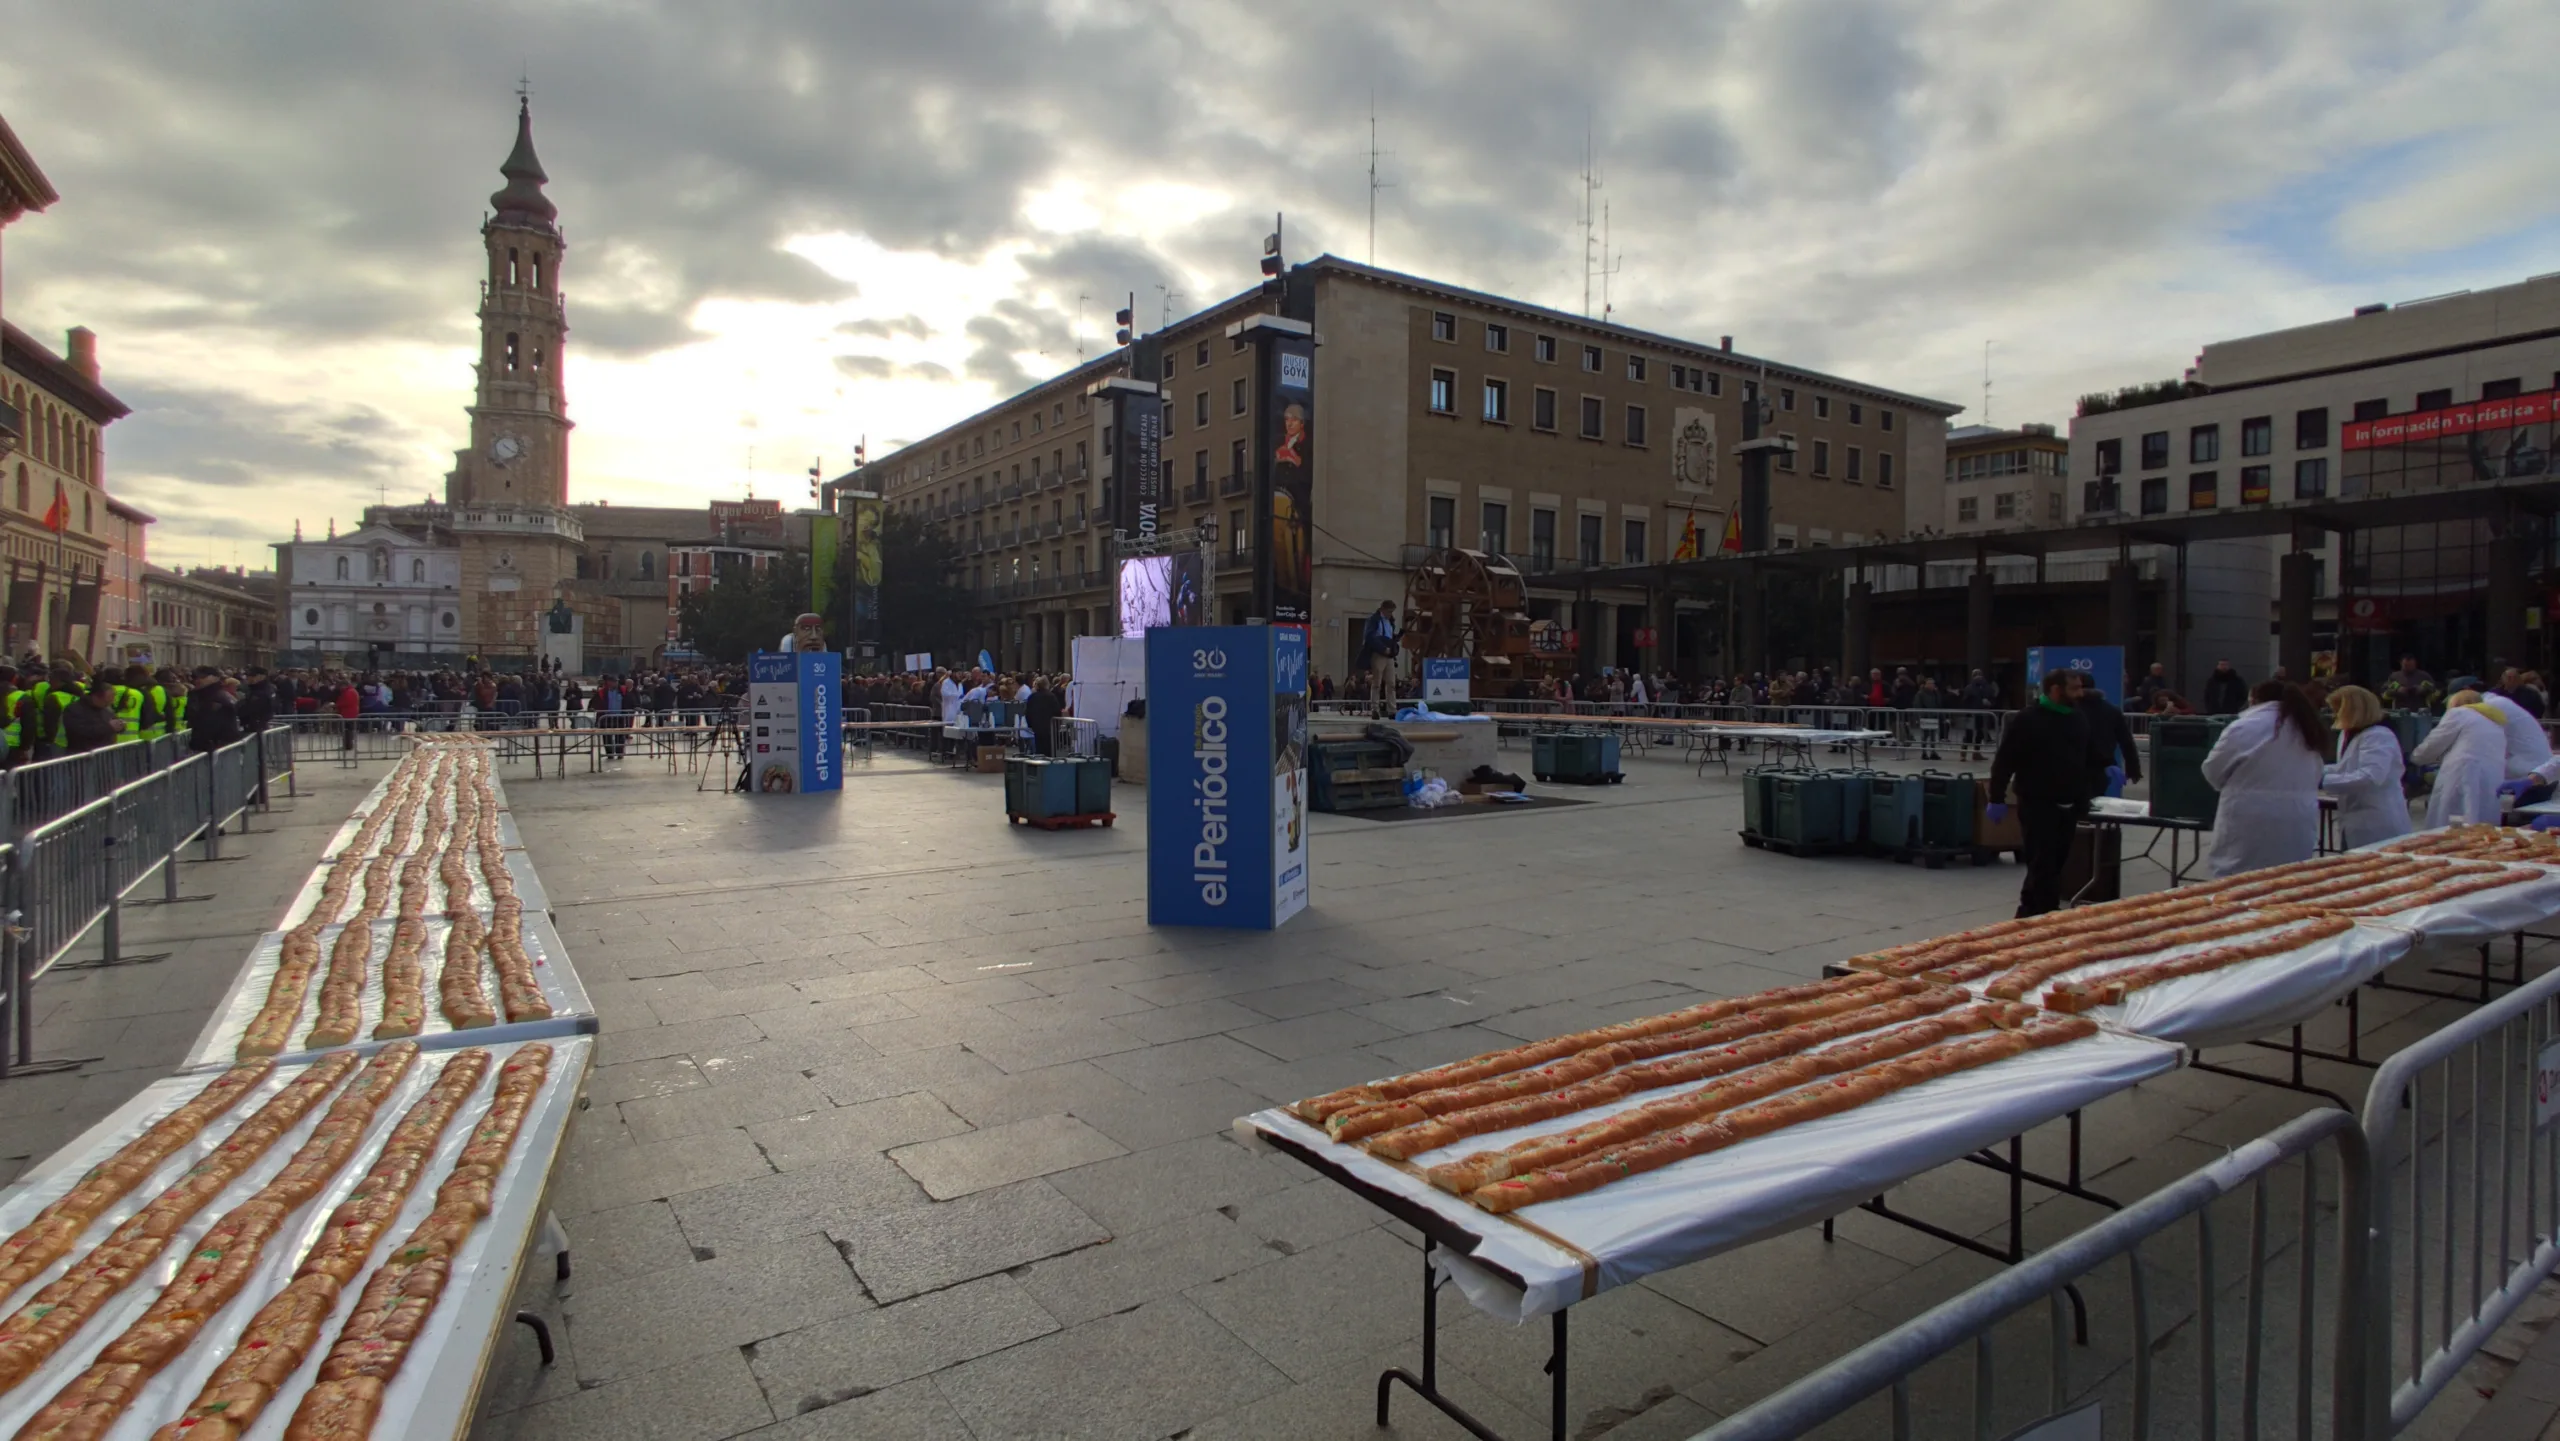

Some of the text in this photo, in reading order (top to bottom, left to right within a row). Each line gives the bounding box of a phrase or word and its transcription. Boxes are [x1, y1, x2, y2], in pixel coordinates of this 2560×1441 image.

[1284, 366, 1307, 379] GOYA
[2356, 417, 2453, 442] Información
[2456, 404, 2534, 425] Turística
[1140, 453, 1148, 495] COLECCIÓN
[1150, 471, 1158, 496] MUSEO
[814, 662, 826, 673] 30
[1193, 648, 1227, 670] 30
[2070, 658, 2093, 670] 30
[815, 684, 828, 764] Periódico
[816, 766, 829, 781] el
[1194, 696, 1228, 906] el Periódico
